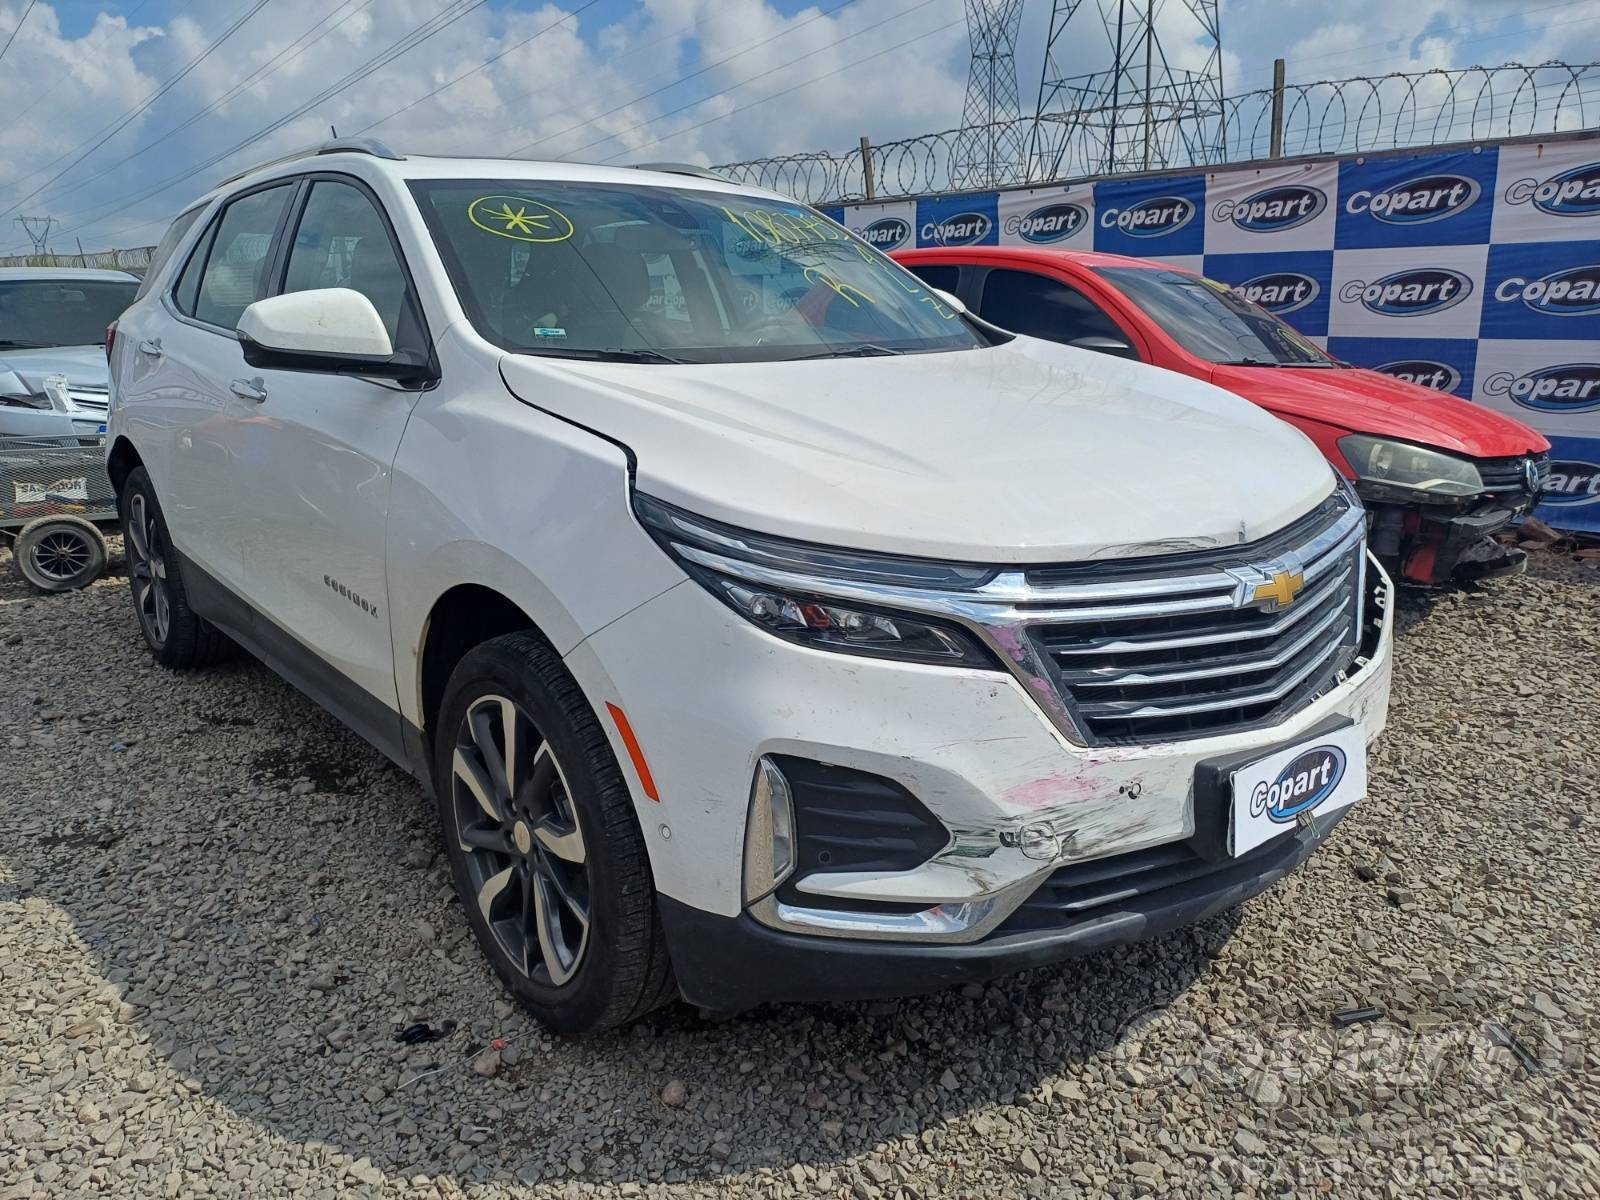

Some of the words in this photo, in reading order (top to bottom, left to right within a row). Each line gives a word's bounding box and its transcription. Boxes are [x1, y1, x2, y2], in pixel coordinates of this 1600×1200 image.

[1346, 182, 1463, 216] Copart
[1504, 177, 1600, 207] Copa
[1004, 210, 1077, 237] Copart
[1101, 202, 1184, 231] Copart
[1211, 193, 1312, 224] Copart
[921, 213, 985, 243] Copart
[1231, 280, 1306, 303] opart
[1339, 278, 1454, 310] Copart
[1494, 278, 1600, 306] Copa
[1482, 371, 1600, 402] Copar
[1250, 755, 1332, 818] Copart
